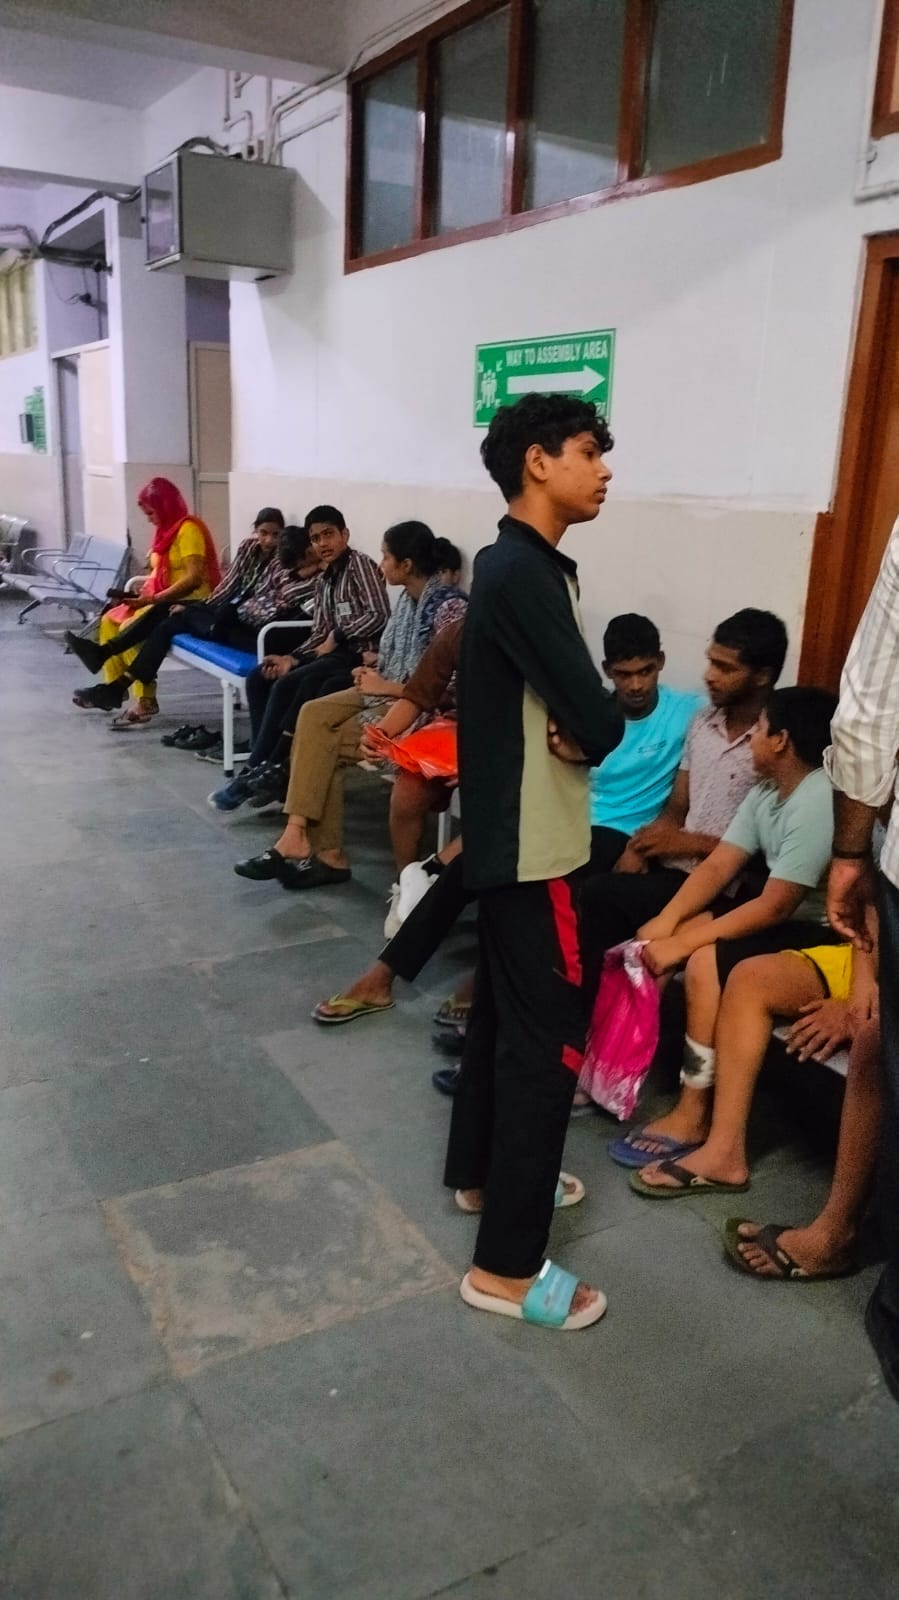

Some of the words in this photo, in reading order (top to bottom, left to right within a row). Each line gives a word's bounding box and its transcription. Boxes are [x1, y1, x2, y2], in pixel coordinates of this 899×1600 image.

[506, 349, 522, 366] WAY
[524, 347, 536, 366] TO
[536, 343, 581, 364] ASSEMBLY
[583, 340, 607, 360] AREA
